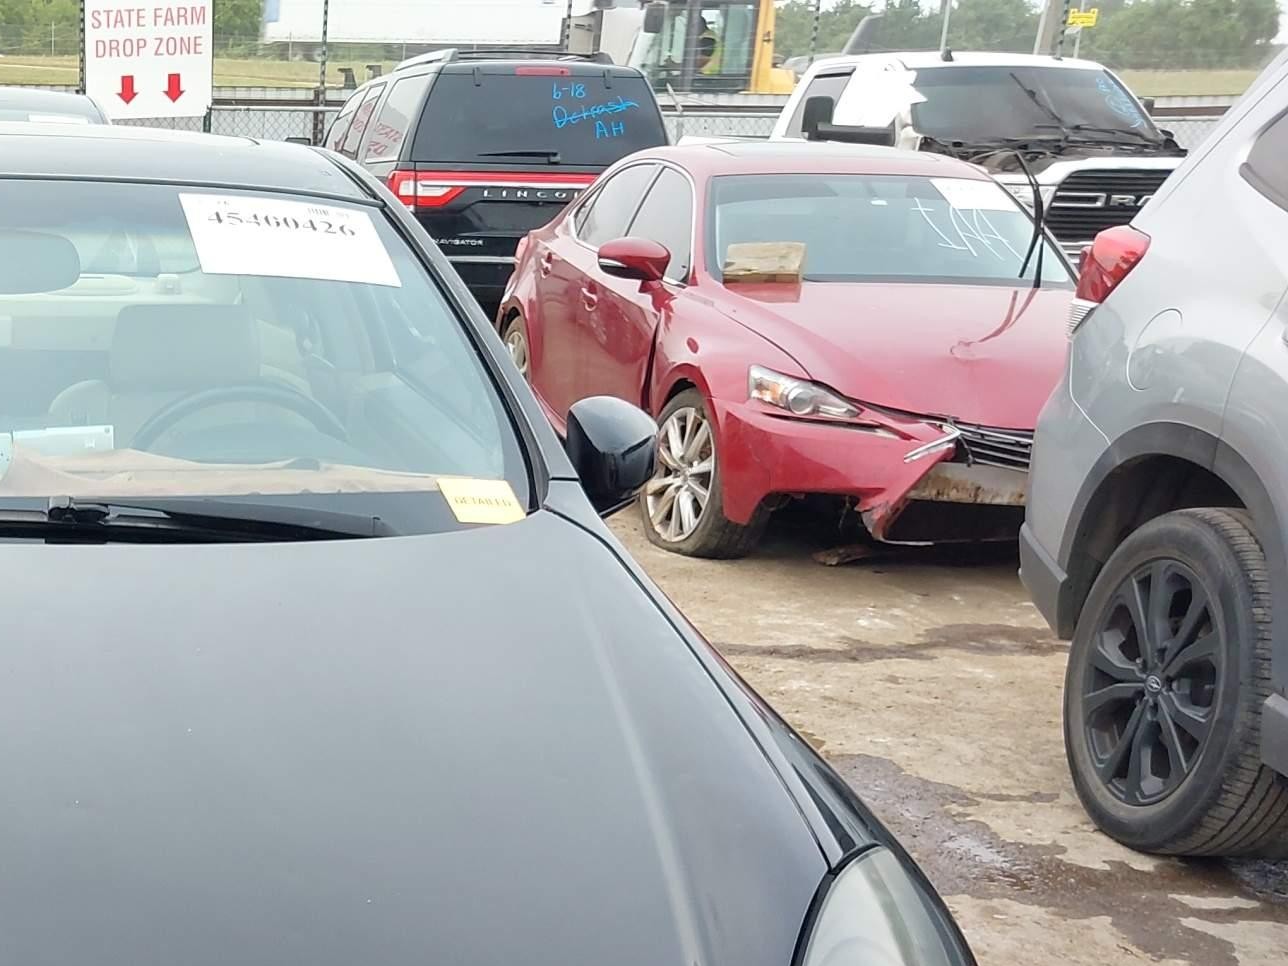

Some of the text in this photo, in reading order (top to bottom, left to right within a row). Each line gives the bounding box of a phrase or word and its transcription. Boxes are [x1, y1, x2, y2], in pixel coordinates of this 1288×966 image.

[91, 6, 206, 29] STATE FARM
[95, 35, 203, 58] DROP ZONE
[553, 82, 586, 99] 6-18
